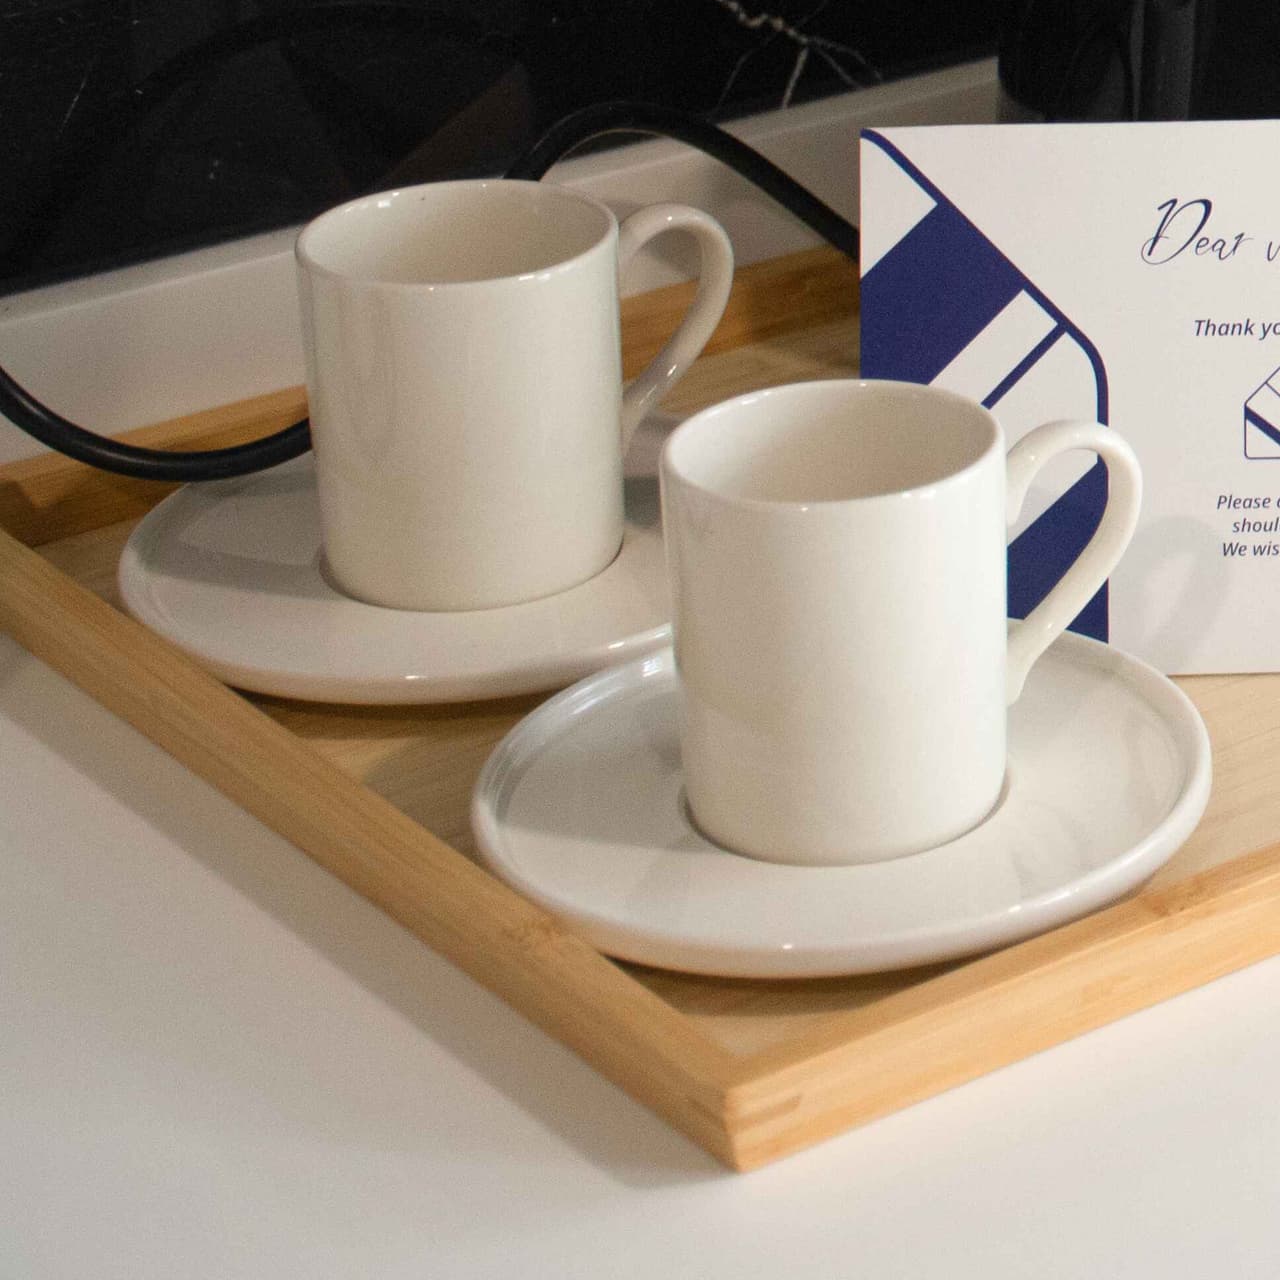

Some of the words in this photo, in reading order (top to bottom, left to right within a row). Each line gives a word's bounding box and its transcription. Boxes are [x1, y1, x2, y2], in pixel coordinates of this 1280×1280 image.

[1140, 198, 1254, 266] Dear
[1194, 317, 1256, 337] Thank
[1216, 493, 1272, 510] Please
[1222, 541, 1248, 557] We
